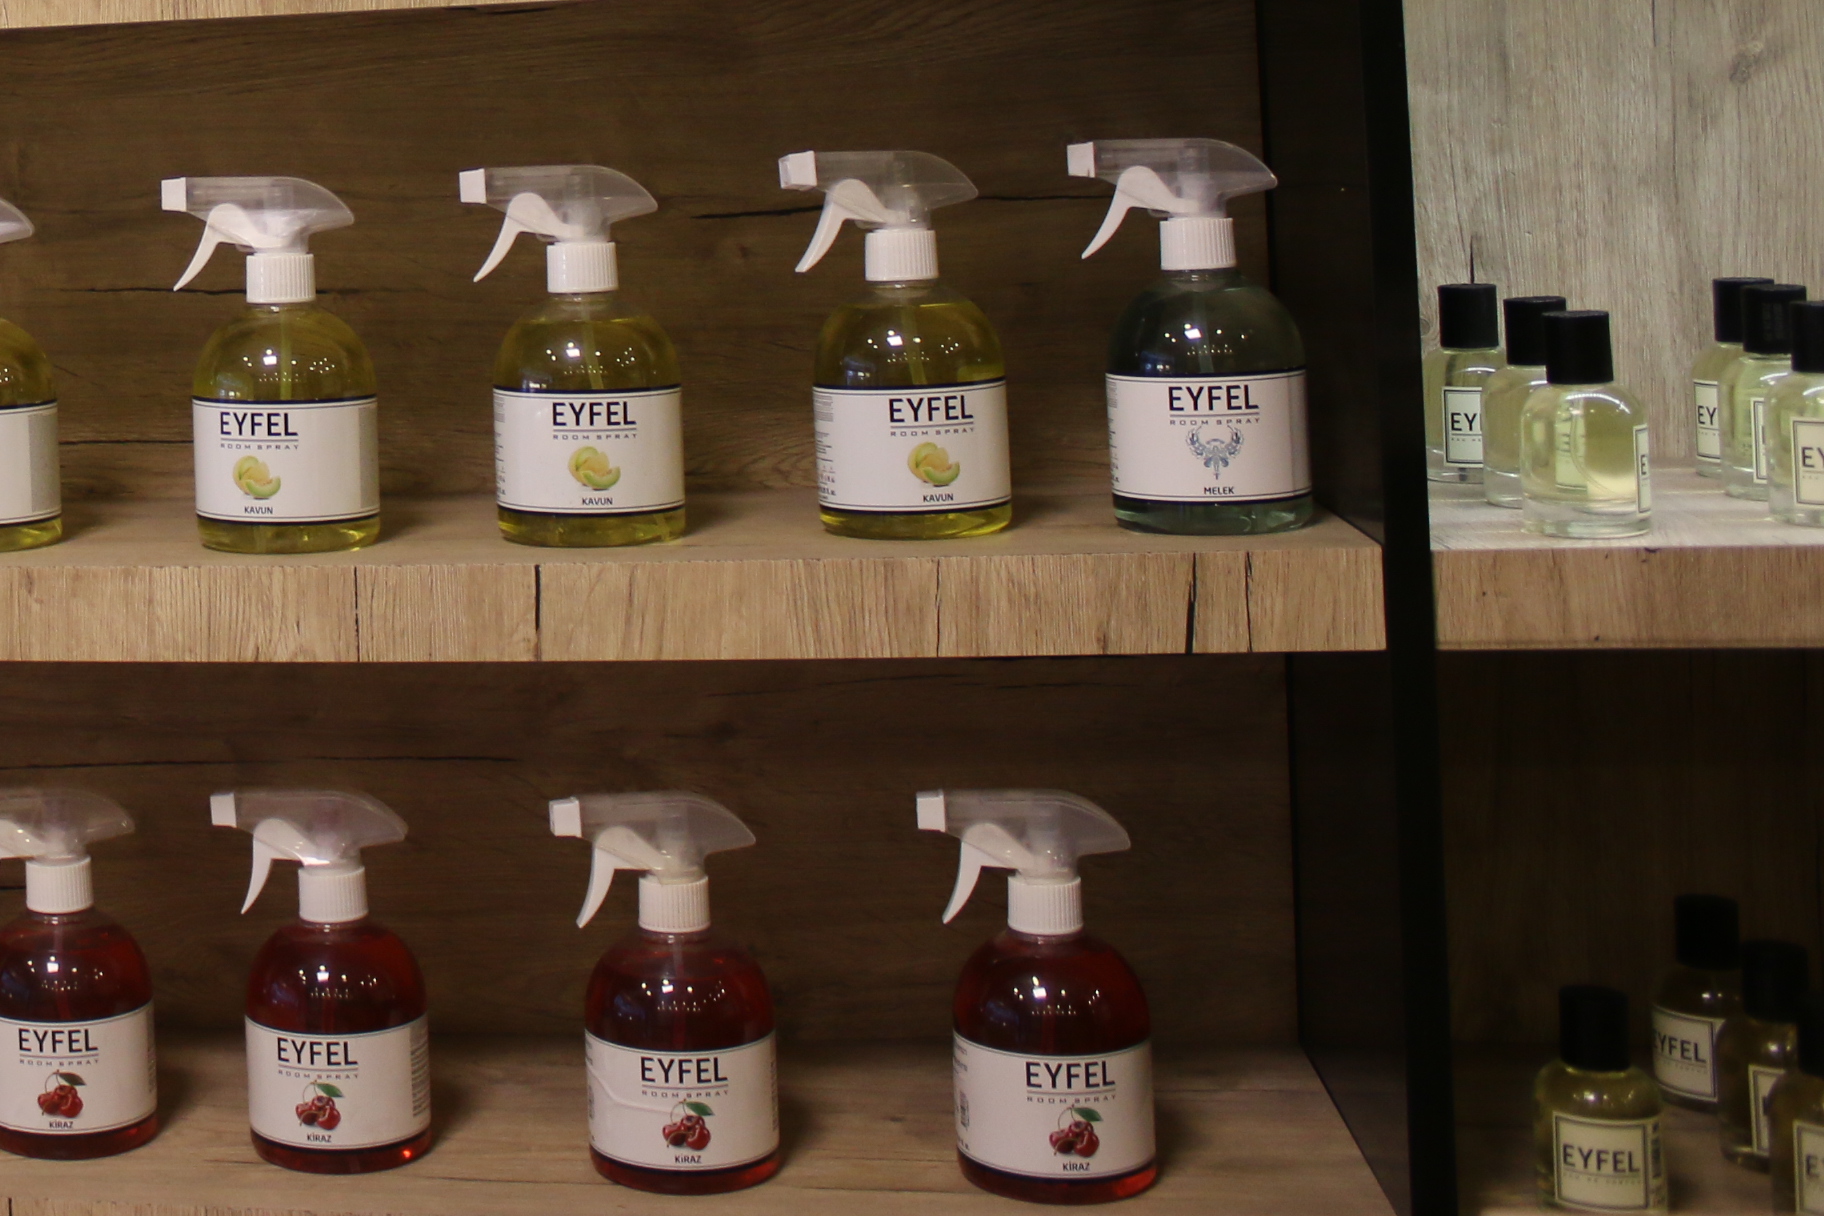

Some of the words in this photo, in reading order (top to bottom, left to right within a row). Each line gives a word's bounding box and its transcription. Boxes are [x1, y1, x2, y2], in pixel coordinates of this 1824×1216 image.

[889, 395, 974, 423] EYFEL
[1168, 384, 1259, 412] EYFEL
[220, 411, 298, 437] EYFEL
[552, 400, 636, 426] EYFEL
[1216, 417, 1260, 425] SPRAY
[935, 427, 975, 435] SPRAY
[581, 497, 613, 506] KAVUN
[922, 493, 954, 502] KAVUN
[1204, 486, 1235, 495] MELEK
[244, 506, 273, 515] KAVUN
[18, 1027, 98, 1053] EYFEL
[277, 1037, 358, 1066] EYFEL
[641, 1056, 728, 1084] EYFEL
[1025, 1060, 1115, 1089] EYFEL
[1562, 1145, 1640, 1173] EYFEL
